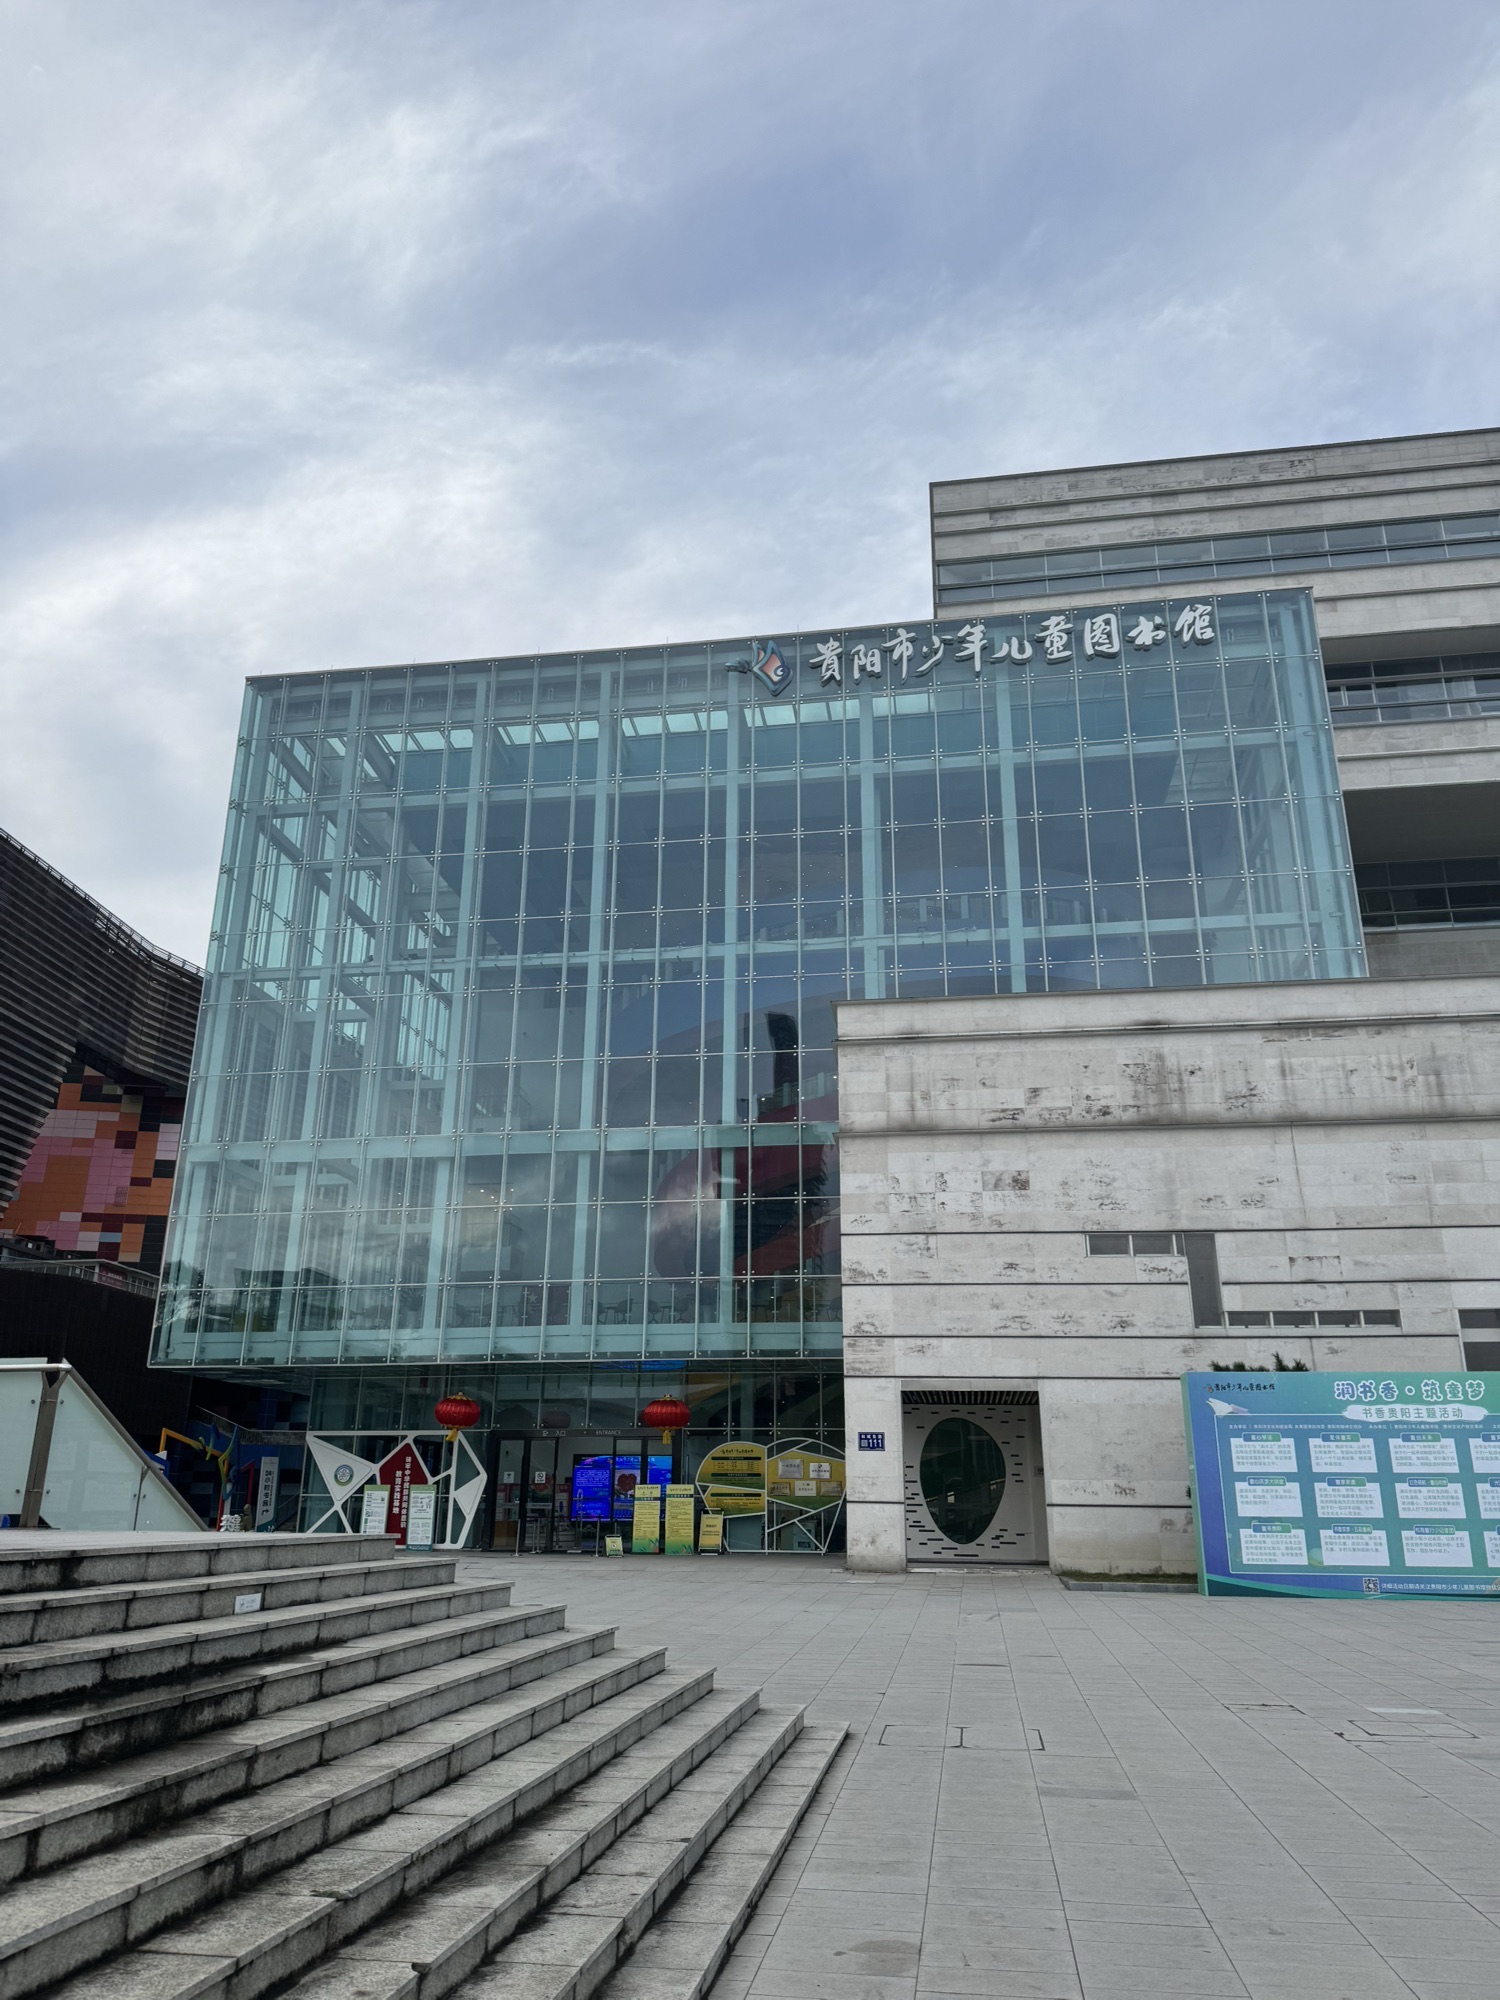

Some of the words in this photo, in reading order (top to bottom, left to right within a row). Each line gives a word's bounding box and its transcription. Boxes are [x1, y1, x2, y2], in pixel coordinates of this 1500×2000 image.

[1334, 1379, 1486, 1401] 润书香·筑童梦
[1362, 1407, 1463, 1419] 书香贵阳主题活动
[869, 1439, 882, 1448] 111
